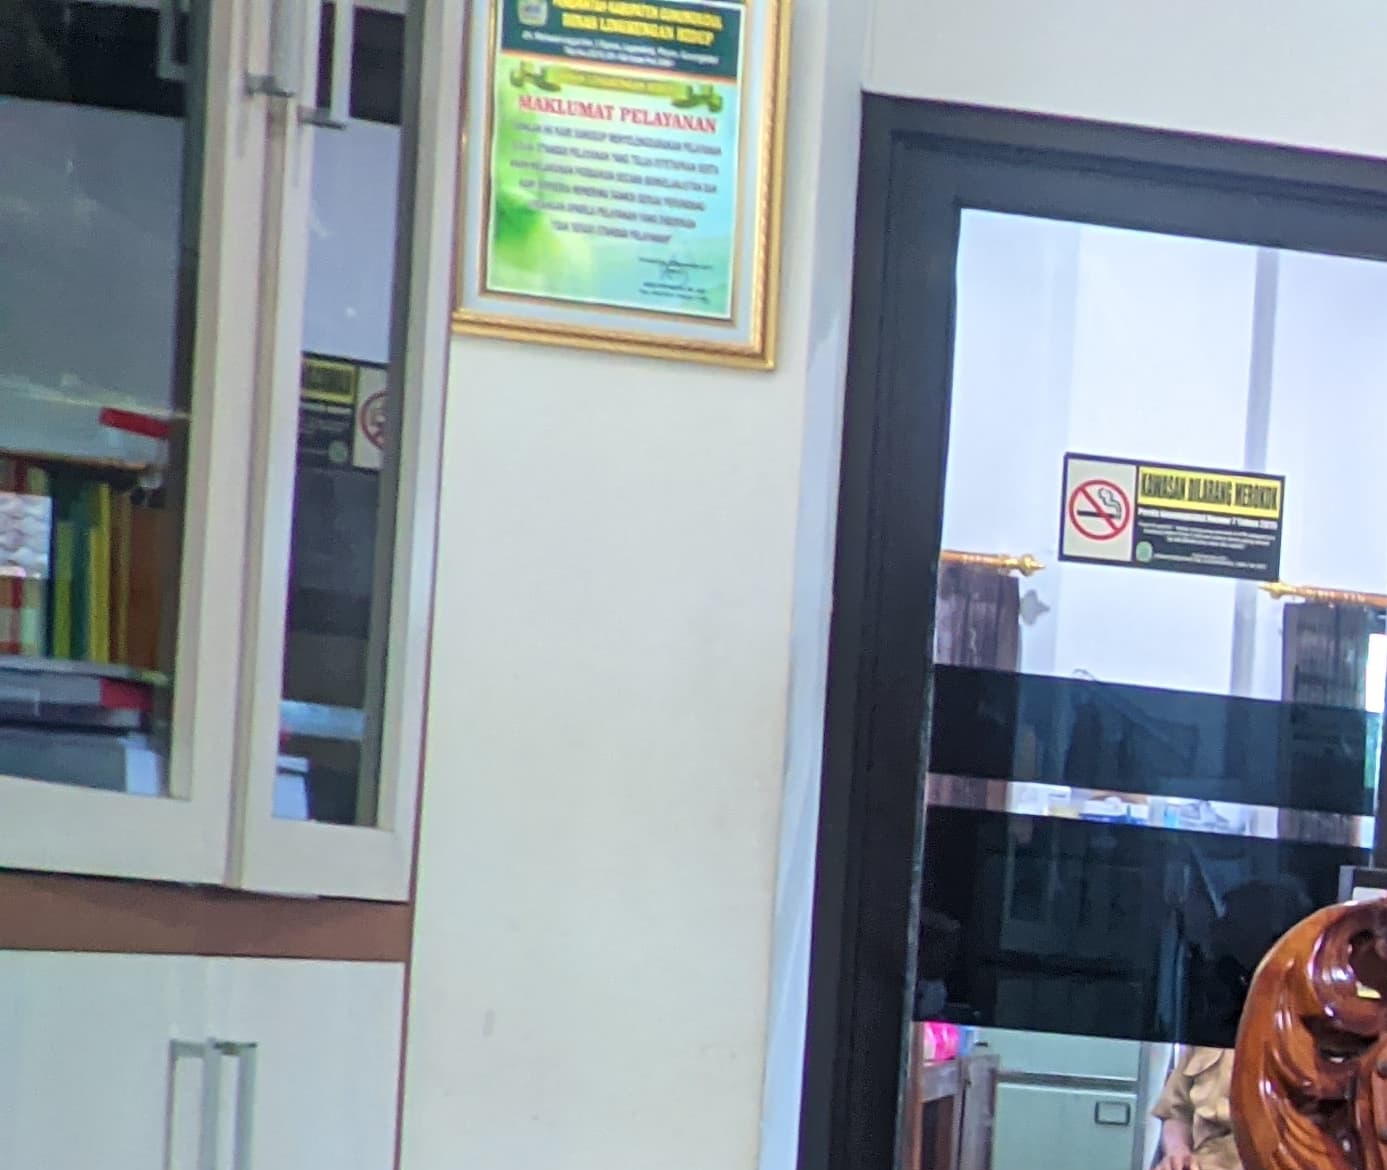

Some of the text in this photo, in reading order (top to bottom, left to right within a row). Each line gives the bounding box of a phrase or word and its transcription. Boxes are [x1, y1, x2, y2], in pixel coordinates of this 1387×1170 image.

[518, 94, 717, 134] MAKLUMAT PELAYANAN
[1142, 472, 1279, 511] KAWASAN DILARANG MEROKOK
